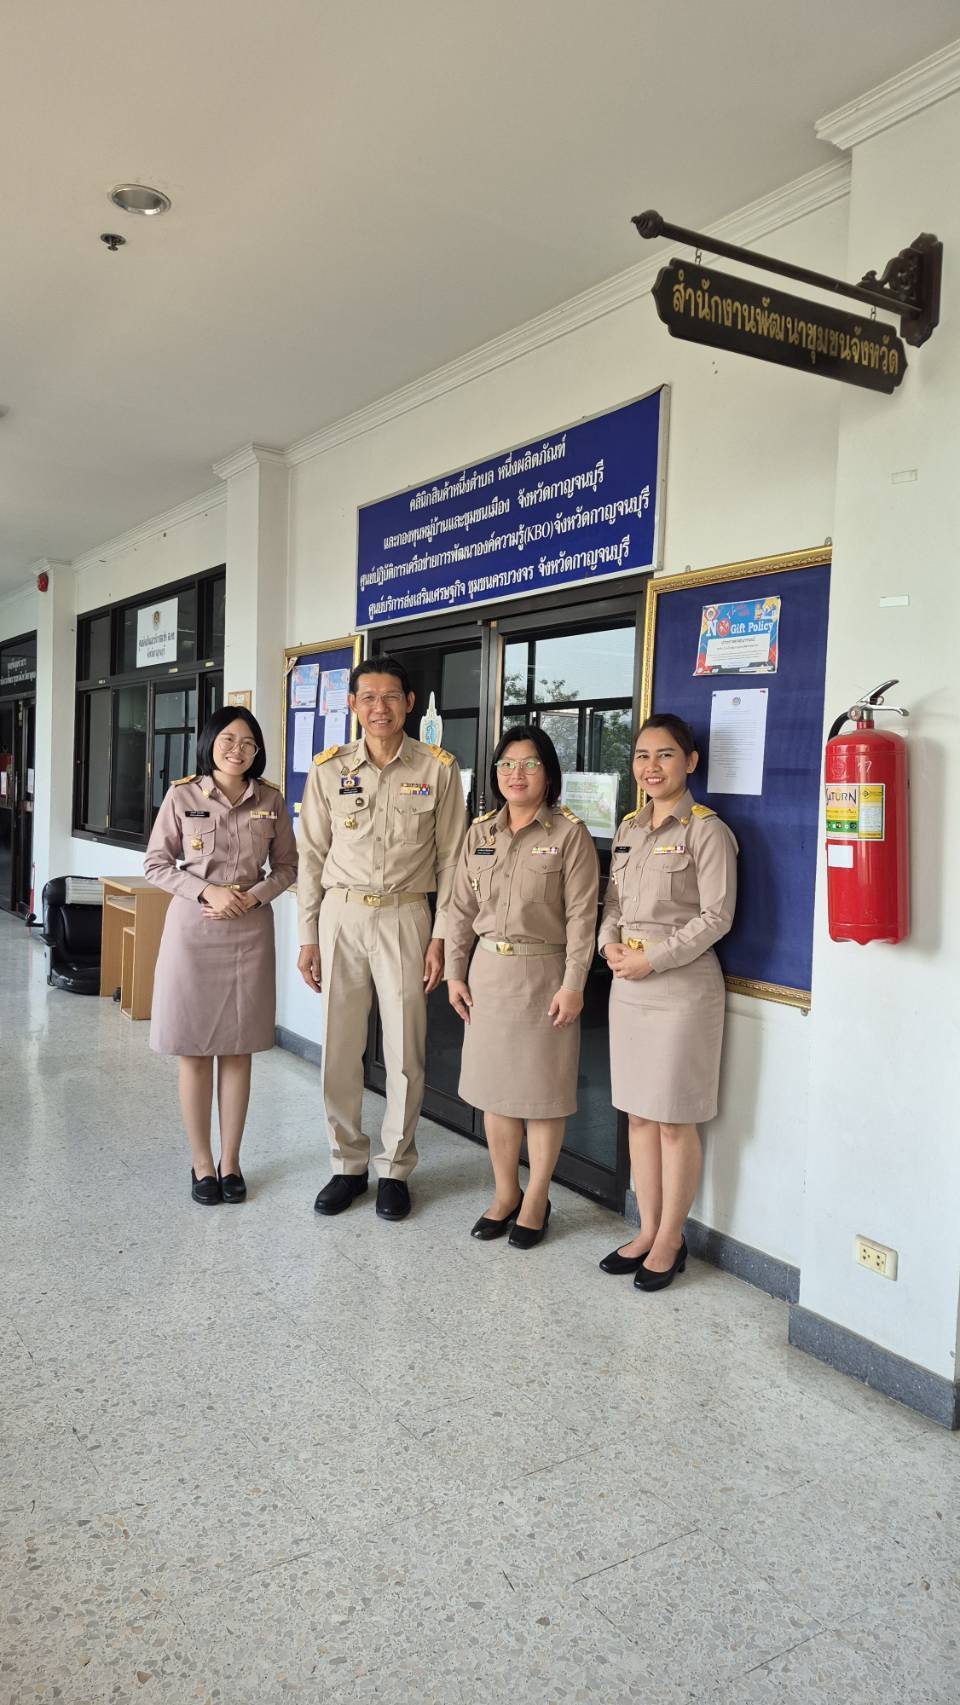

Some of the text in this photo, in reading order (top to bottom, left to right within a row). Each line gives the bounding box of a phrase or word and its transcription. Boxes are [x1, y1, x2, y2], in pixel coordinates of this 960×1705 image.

[673, 269, 899, 375] สำนักงานพัฒนาชุมชนจังหวัด
[498, 434, 567, 482] หนึ่งผลิตภัณฑ์
[383, 458, 604, 550] และกองทุนหมู่บ้านและชุมชนเมือง จังหวัดกาญจนบุรี
[368, 534, 631, 621] ศูนย์บริการส่งเสริมเศรษฐกิจ ชุมชนครบวงจร จังหวัดกาญจนบุรี
[731, 622, 746, 634] Gift
[748, 620, 774, 633] Policy
